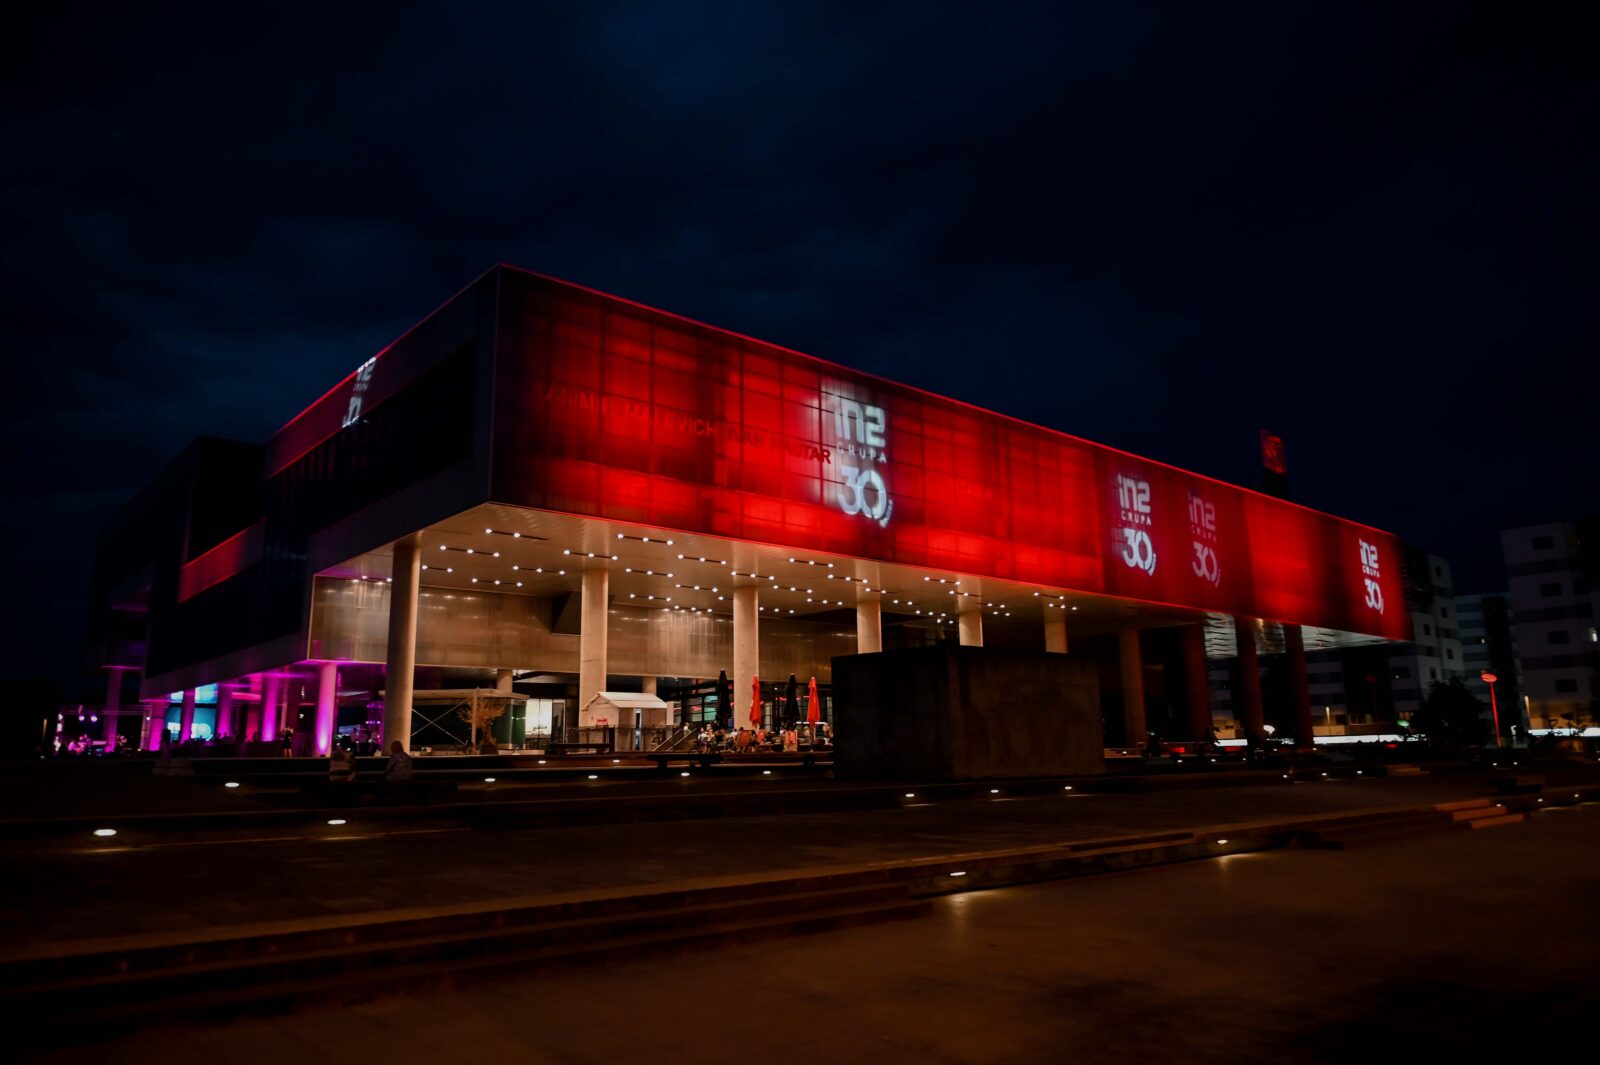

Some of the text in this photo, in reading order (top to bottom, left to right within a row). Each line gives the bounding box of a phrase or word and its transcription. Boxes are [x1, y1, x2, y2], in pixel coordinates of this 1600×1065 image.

[833, 395, 886, 448] in2
[836, 440, 888, 464] GRUPA
[837, 465, 887, 520] 30
[1117, 474, 1151, 514] in2
[1121, 510, 1152, 526] GRUPA
[1122, 527, 1153, 573] 30
